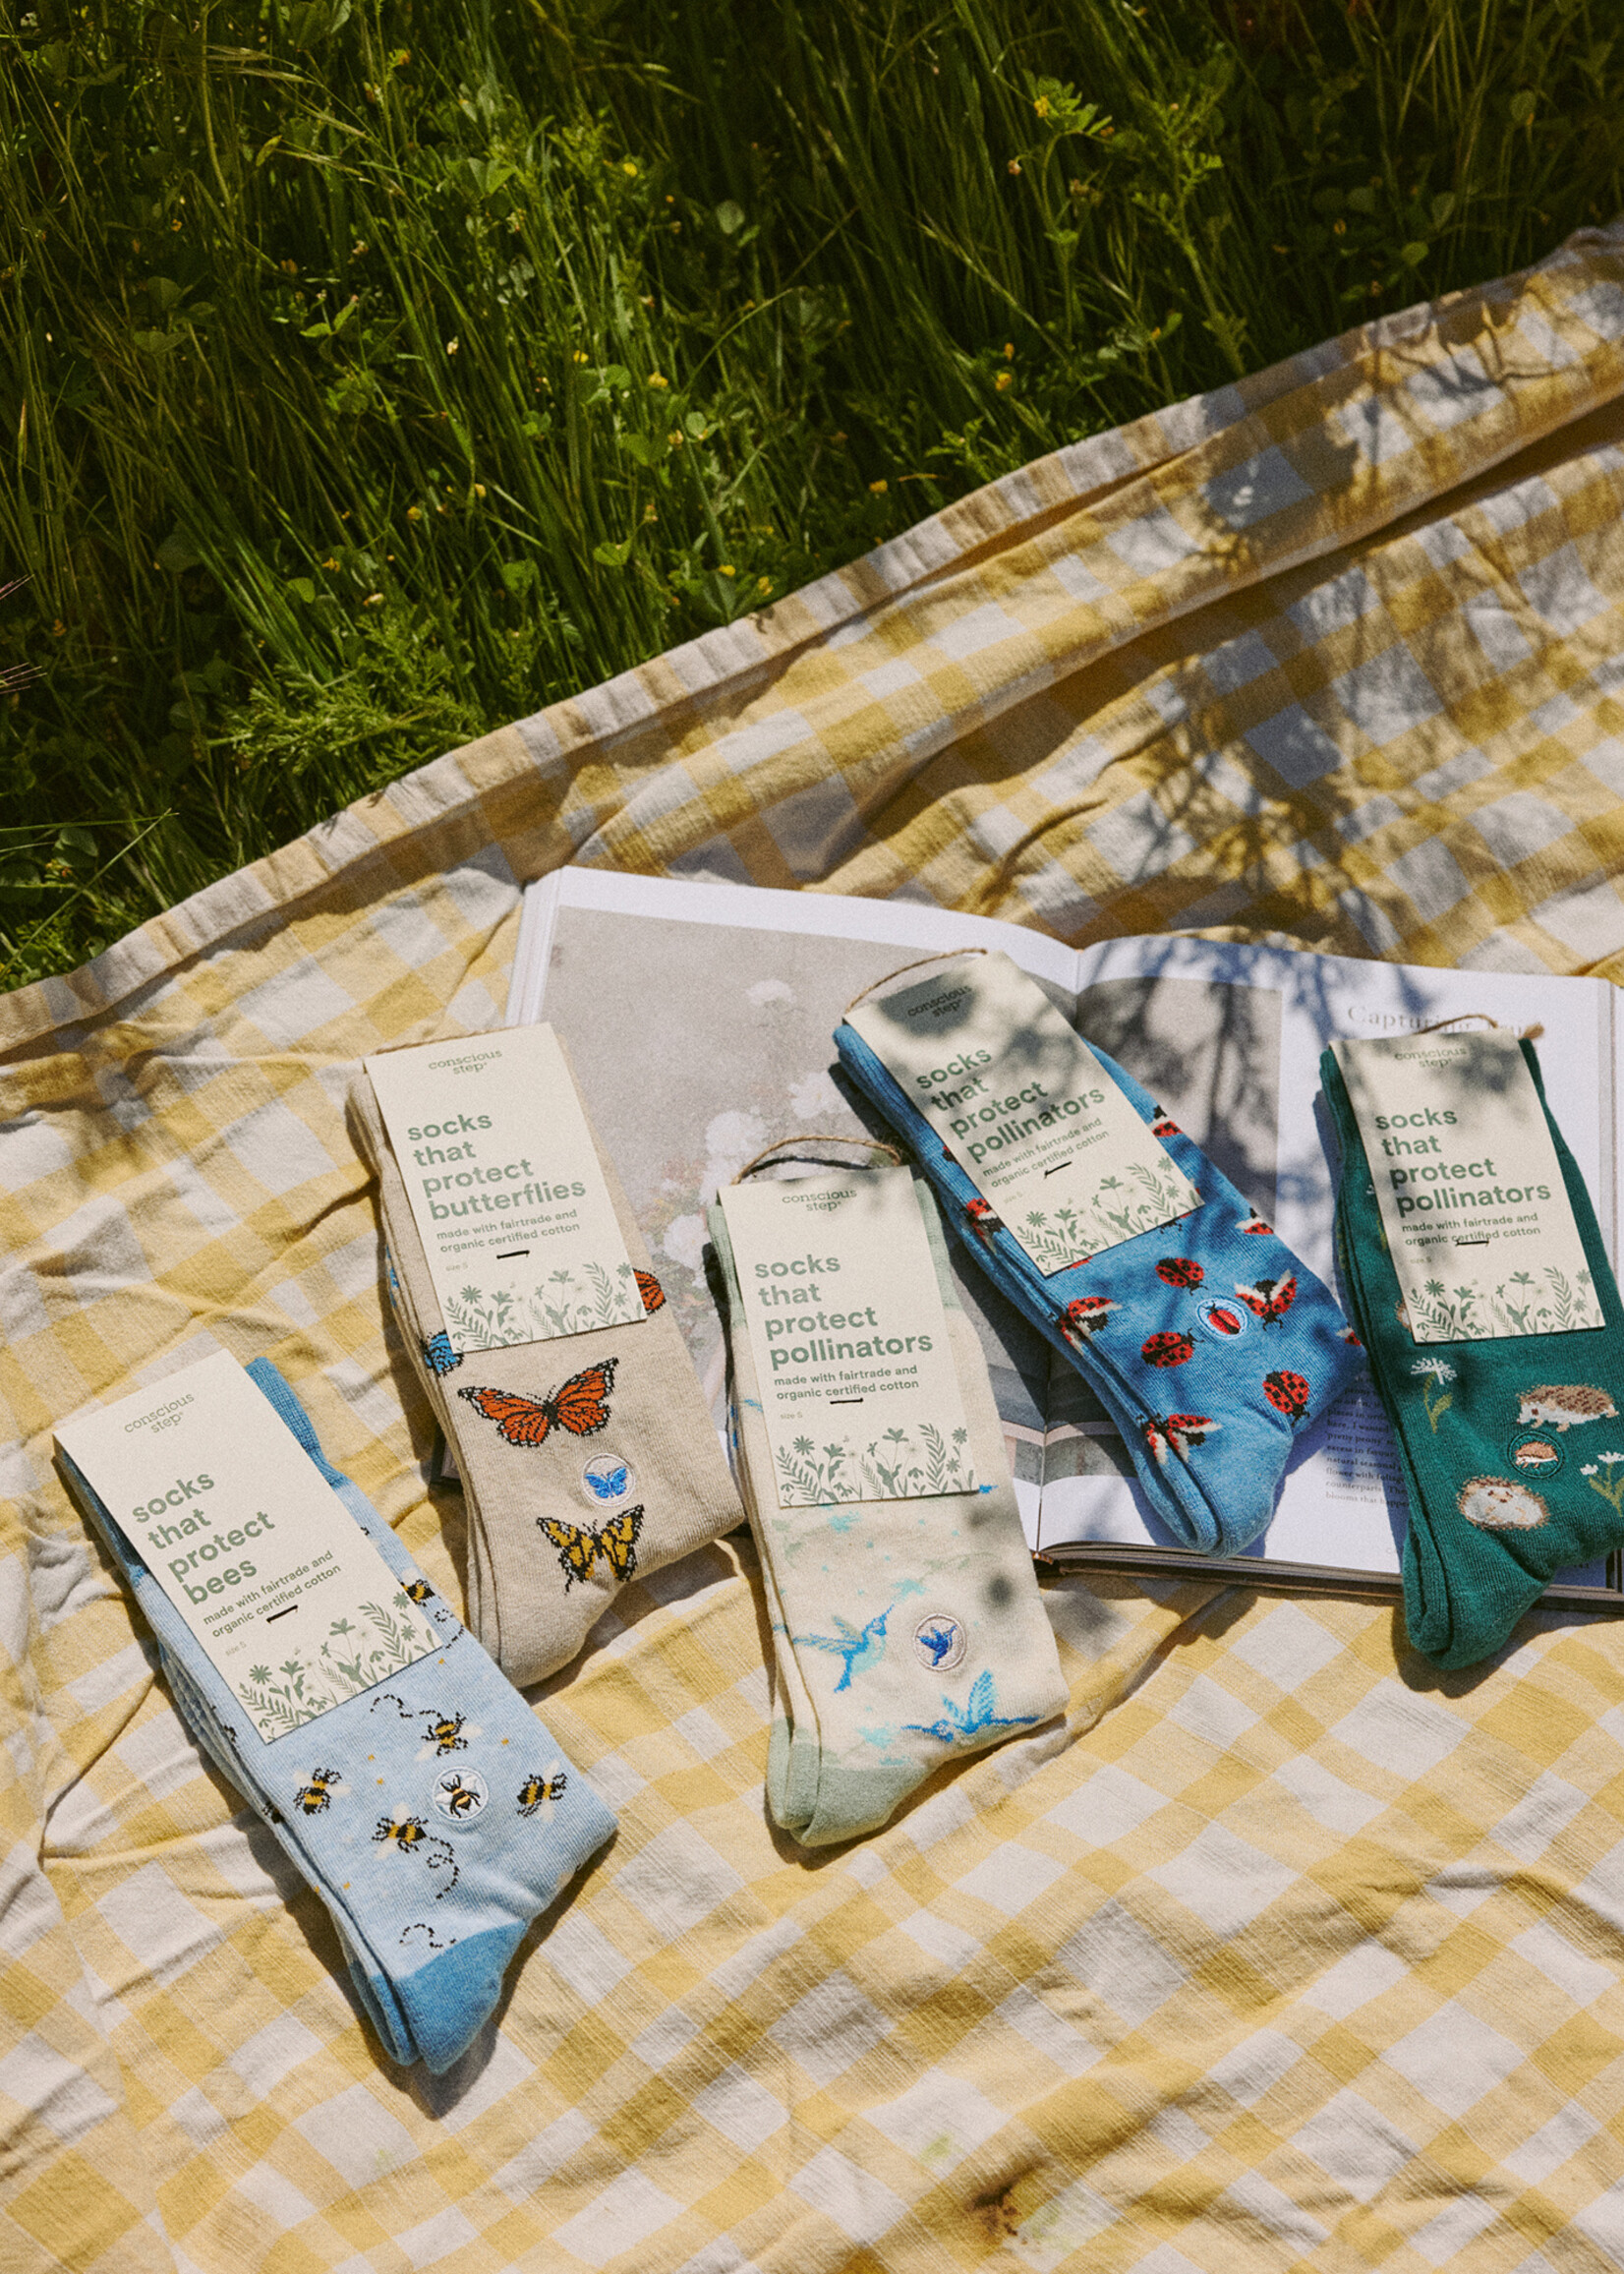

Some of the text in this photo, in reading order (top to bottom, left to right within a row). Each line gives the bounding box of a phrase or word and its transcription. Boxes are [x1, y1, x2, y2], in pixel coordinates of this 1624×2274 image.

[907, 984, 972, 1018] conscious
[428, 1049, 502, 1071] conscious
[916, 1048, 992, 1090] socks
[1394, 1046, 1467, 1061] conscious
[931, 1077, 990, 1113] that
[949, 1080, 1049, 1140] protect
[408, 1114, 493, 1141] socks
[966, 1085, 1105, 1165] pollinators
[1375, 1108, 1458, 1131] socks
[413, 1141, 477, 1167] that
[983, 1118, 1102, 1177] made with fairtrade and
[991, 1131, 1109, 1188] organic certified cotton
[1381, 1134, 1442, 1157] that
[422, 1158, 535, 1198] protect
[1389, 1158, 1497, 1190] protect
[430, 1180, 586, 1221] butterflies
[782, 1188, 857, 1204] conscious
[1396, 1184, 1551, 1218] pollinators
[436, 1209, 578, 1240] made with fairtrade and
[439, 1223, 580, 1254] organic certified cotton
[1402, 1212, 1538, 1233] made with fairtrade and
[1405, 1227, 1540, 1247] organic certified cotton
[754, 1254, 841, 1278] socks
[758, 1283, 822, 1307] that
[765, 1307, 878, 1342] protect
[770, 1335, 934, 1371] pollinators
[774, 1365, 918, 1386] made with fairtrade and
[777, 1379, 919, 1402] organic certified cotton
[124, 1392, 195, 1433] conscious
[1356, 1471, 1374, 1480] with
[1360, 1460, 1396, 1470] seasonal
[132, 1473, 214, 1524] socks
[1325, 1490, 1358, 1502] blooms
[1360, 1494, 1377, 1504] that
[148, 1507, 211, 1550] that
[167, 1510, 275, 1583] protect
[183, 1560, 257, 1604] bees
[203, 1550, 333, 1625] made with fairtrade and
[212, 1564, 342, 1638] organic certified cotton
